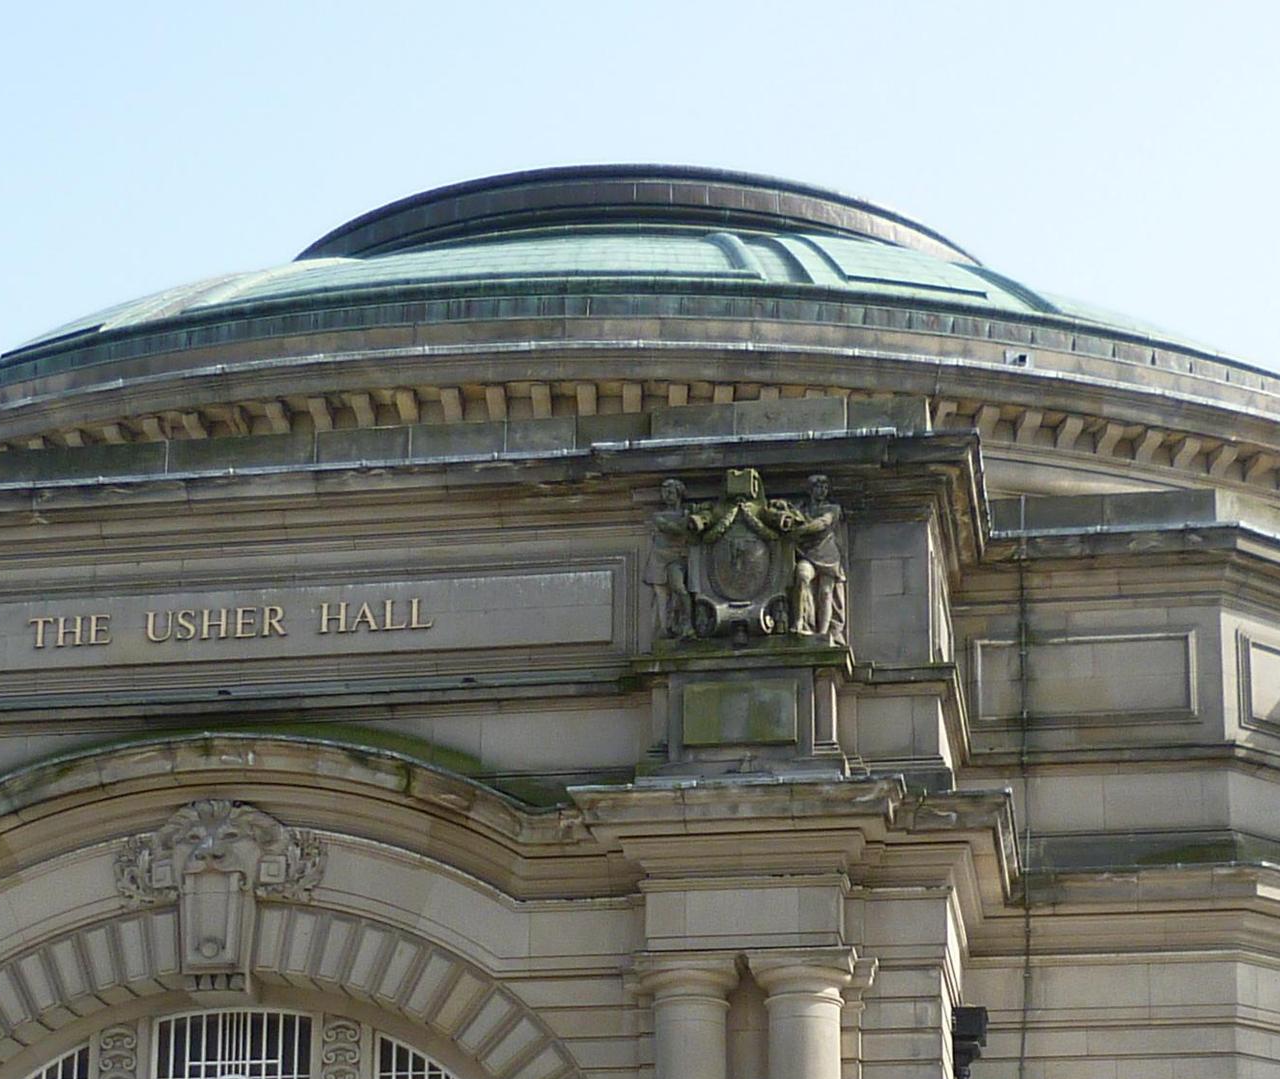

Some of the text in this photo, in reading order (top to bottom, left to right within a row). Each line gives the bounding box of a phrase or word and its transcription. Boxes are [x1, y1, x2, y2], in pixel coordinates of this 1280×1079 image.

[29, 597, 434, 649] THE USHER HALL
